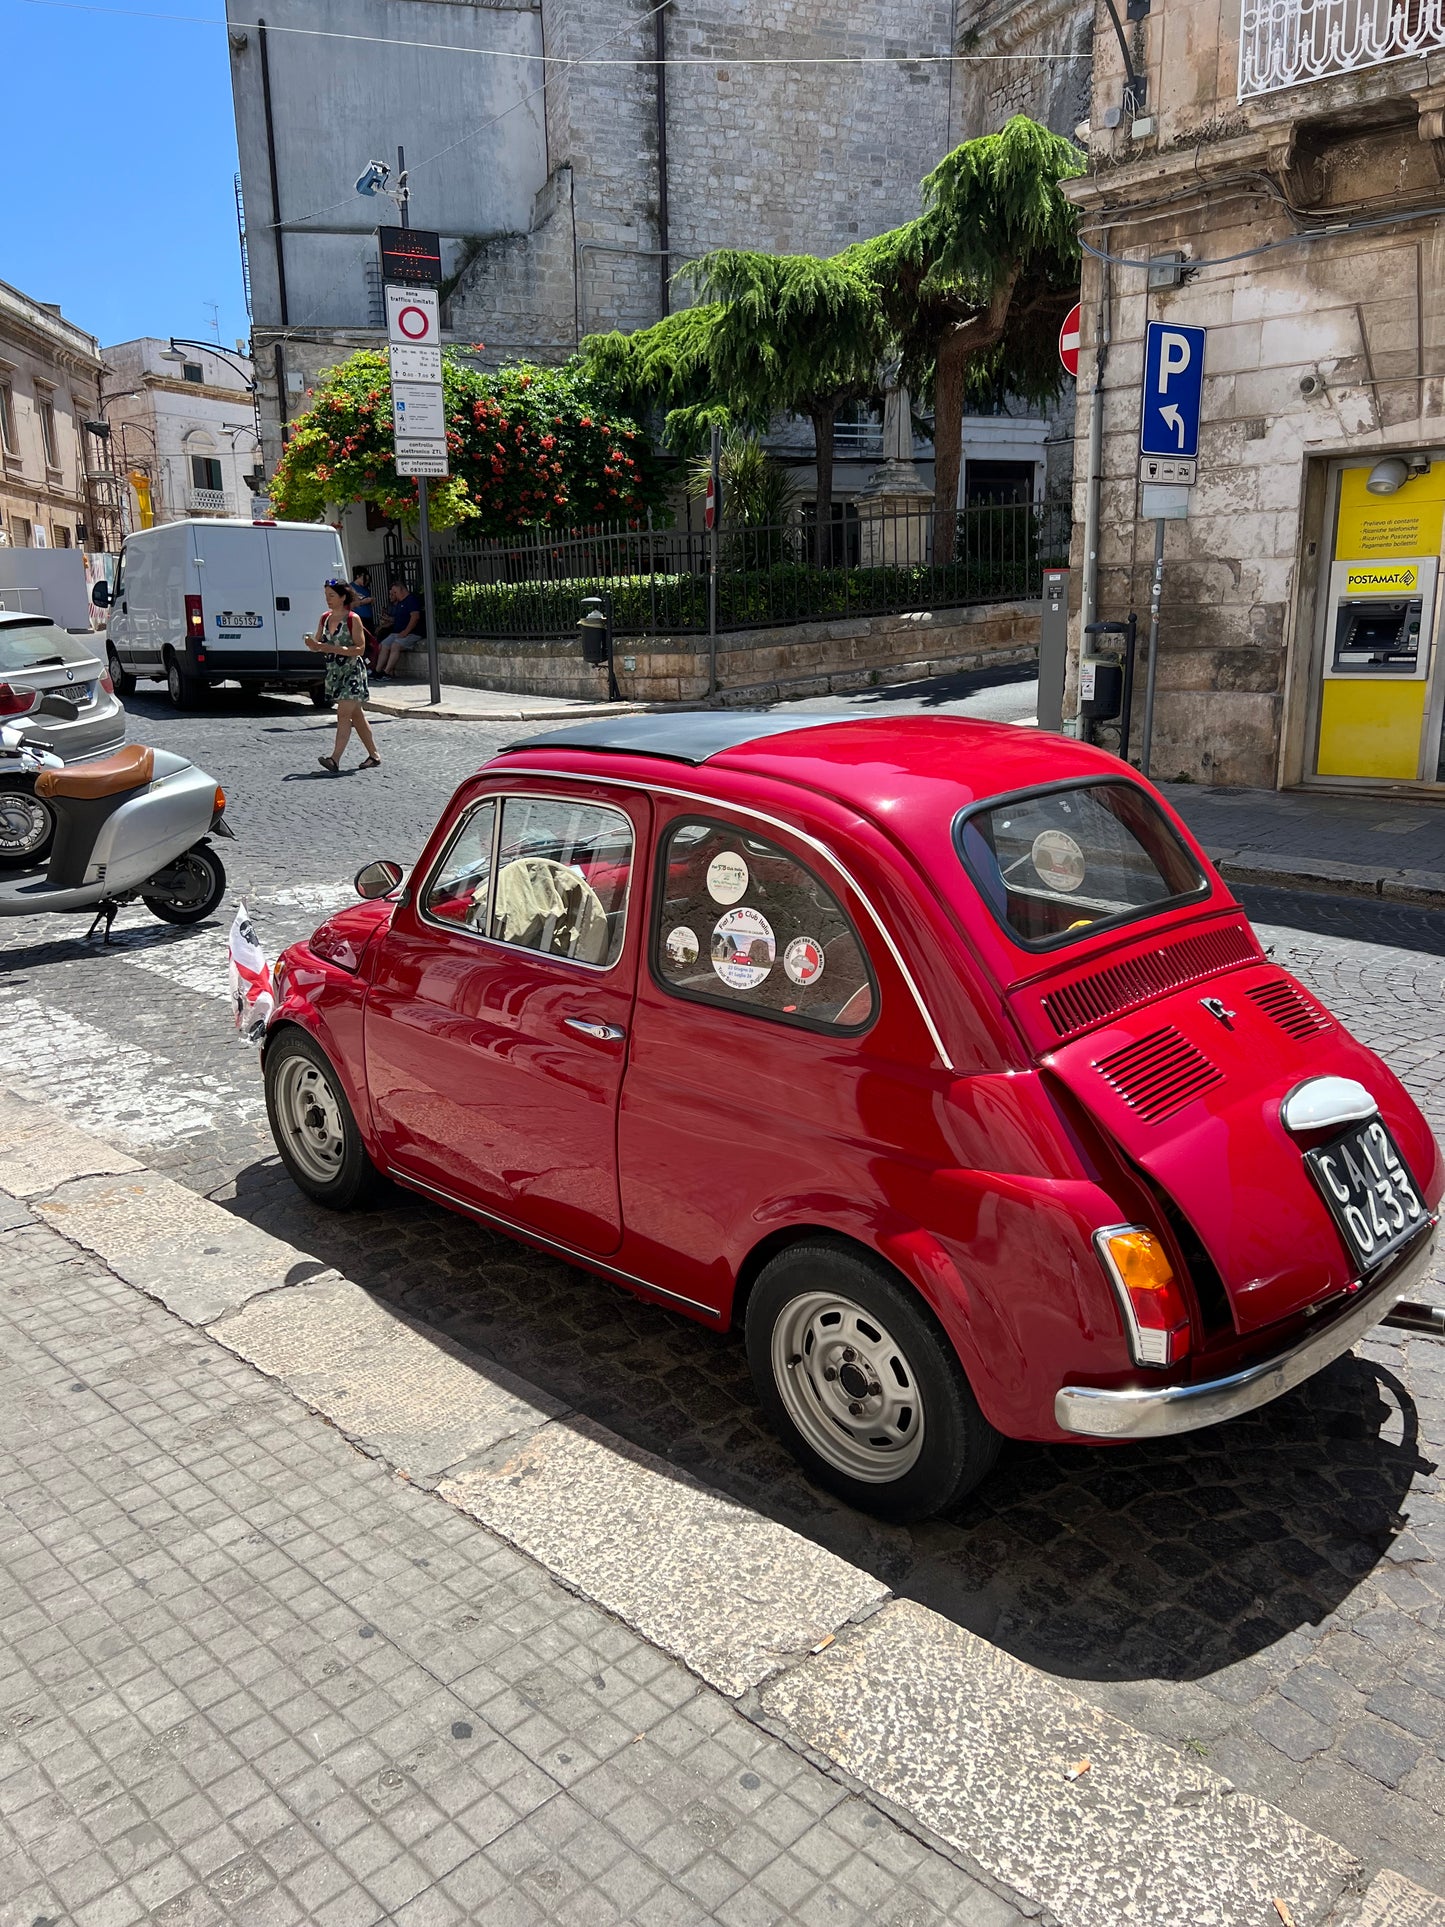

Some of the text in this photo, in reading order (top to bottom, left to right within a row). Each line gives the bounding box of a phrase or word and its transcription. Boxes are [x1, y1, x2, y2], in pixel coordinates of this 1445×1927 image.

[1158, 331, 1191, 394] P
[1361, 533, 1418, 542] Ricariche Postepay
[1348, 574, 1400, 584] POSTAMAT
[718, 917, 729, 930] Fiat
[744, 909, 759, 922] Club
[758, 918, 770, 936] Italia
[717, 966, 727, 978] Tour
[725, 975, 747, 988] Sardegna
[1343, 1168, 1421, 1253] 0433
